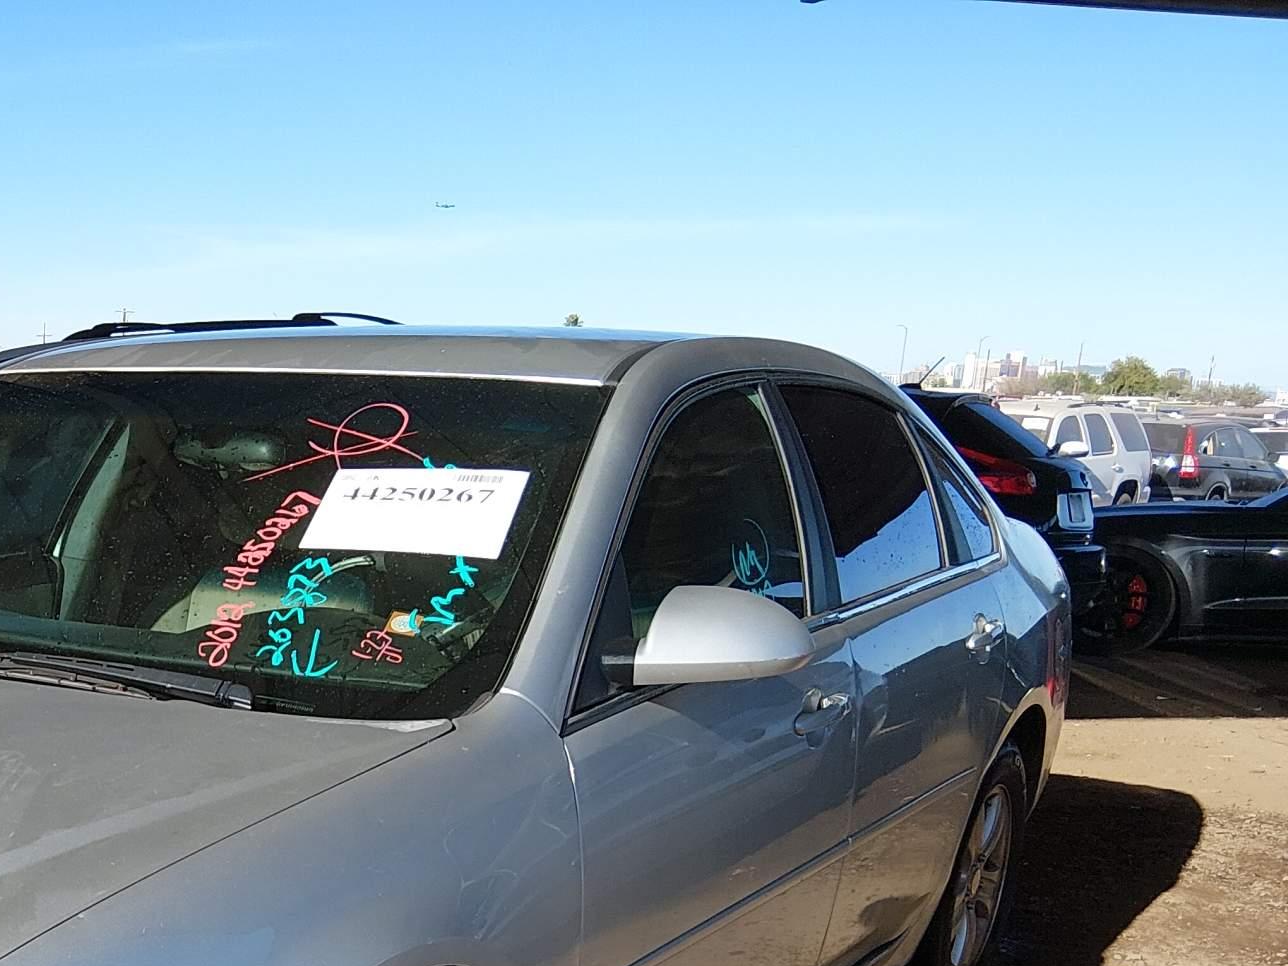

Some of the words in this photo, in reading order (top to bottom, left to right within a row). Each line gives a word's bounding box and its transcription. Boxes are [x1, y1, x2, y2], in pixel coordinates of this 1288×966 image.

[343, 486, 495, 504] 44250267
[223, 490, 322, 592] 44250267
[198, 601, 254, 667] 2012
